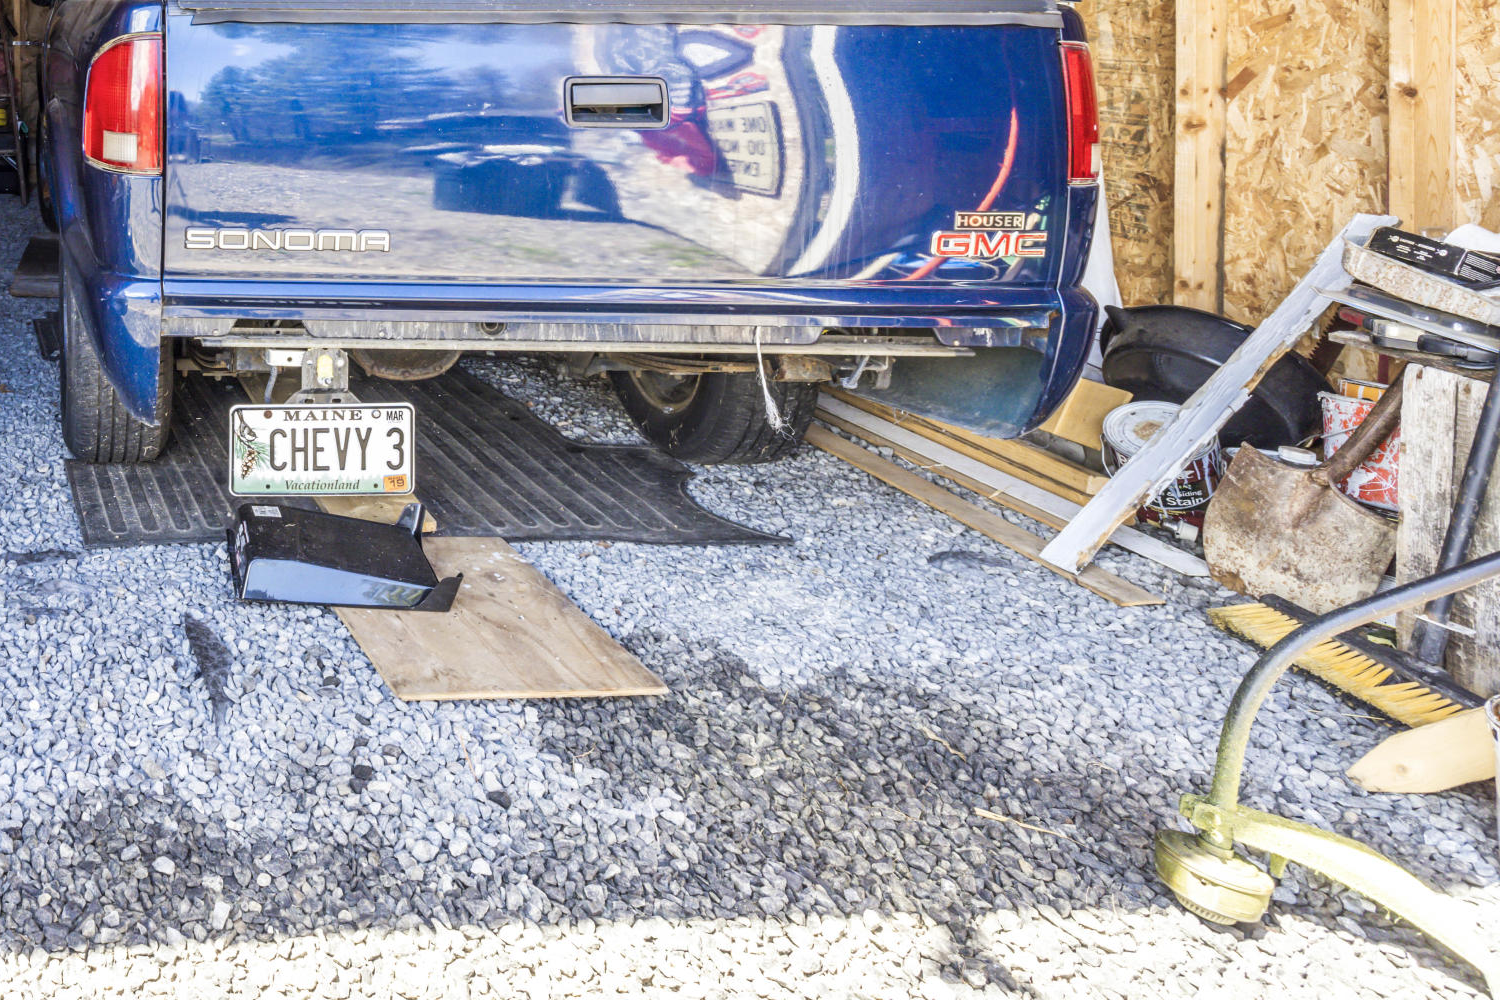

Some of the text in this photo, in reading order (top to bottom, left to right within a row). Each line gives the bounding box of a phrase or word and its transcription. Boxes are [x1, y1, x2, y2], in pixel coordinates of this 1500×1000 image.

[957, 215, 1022, 228] HOUSER
[185, 227, 390, 251] SONOMA
[930, 230, 1048, 257] GMC
[283, 409, 404, 421] MAINE MAR
[269, 427, 405, 471] CHEVY 3
[285, 478, 360, 491] Vacationland
[389, 478, 405, 488] 19
[1166, 496, 1204, 507] Stain
